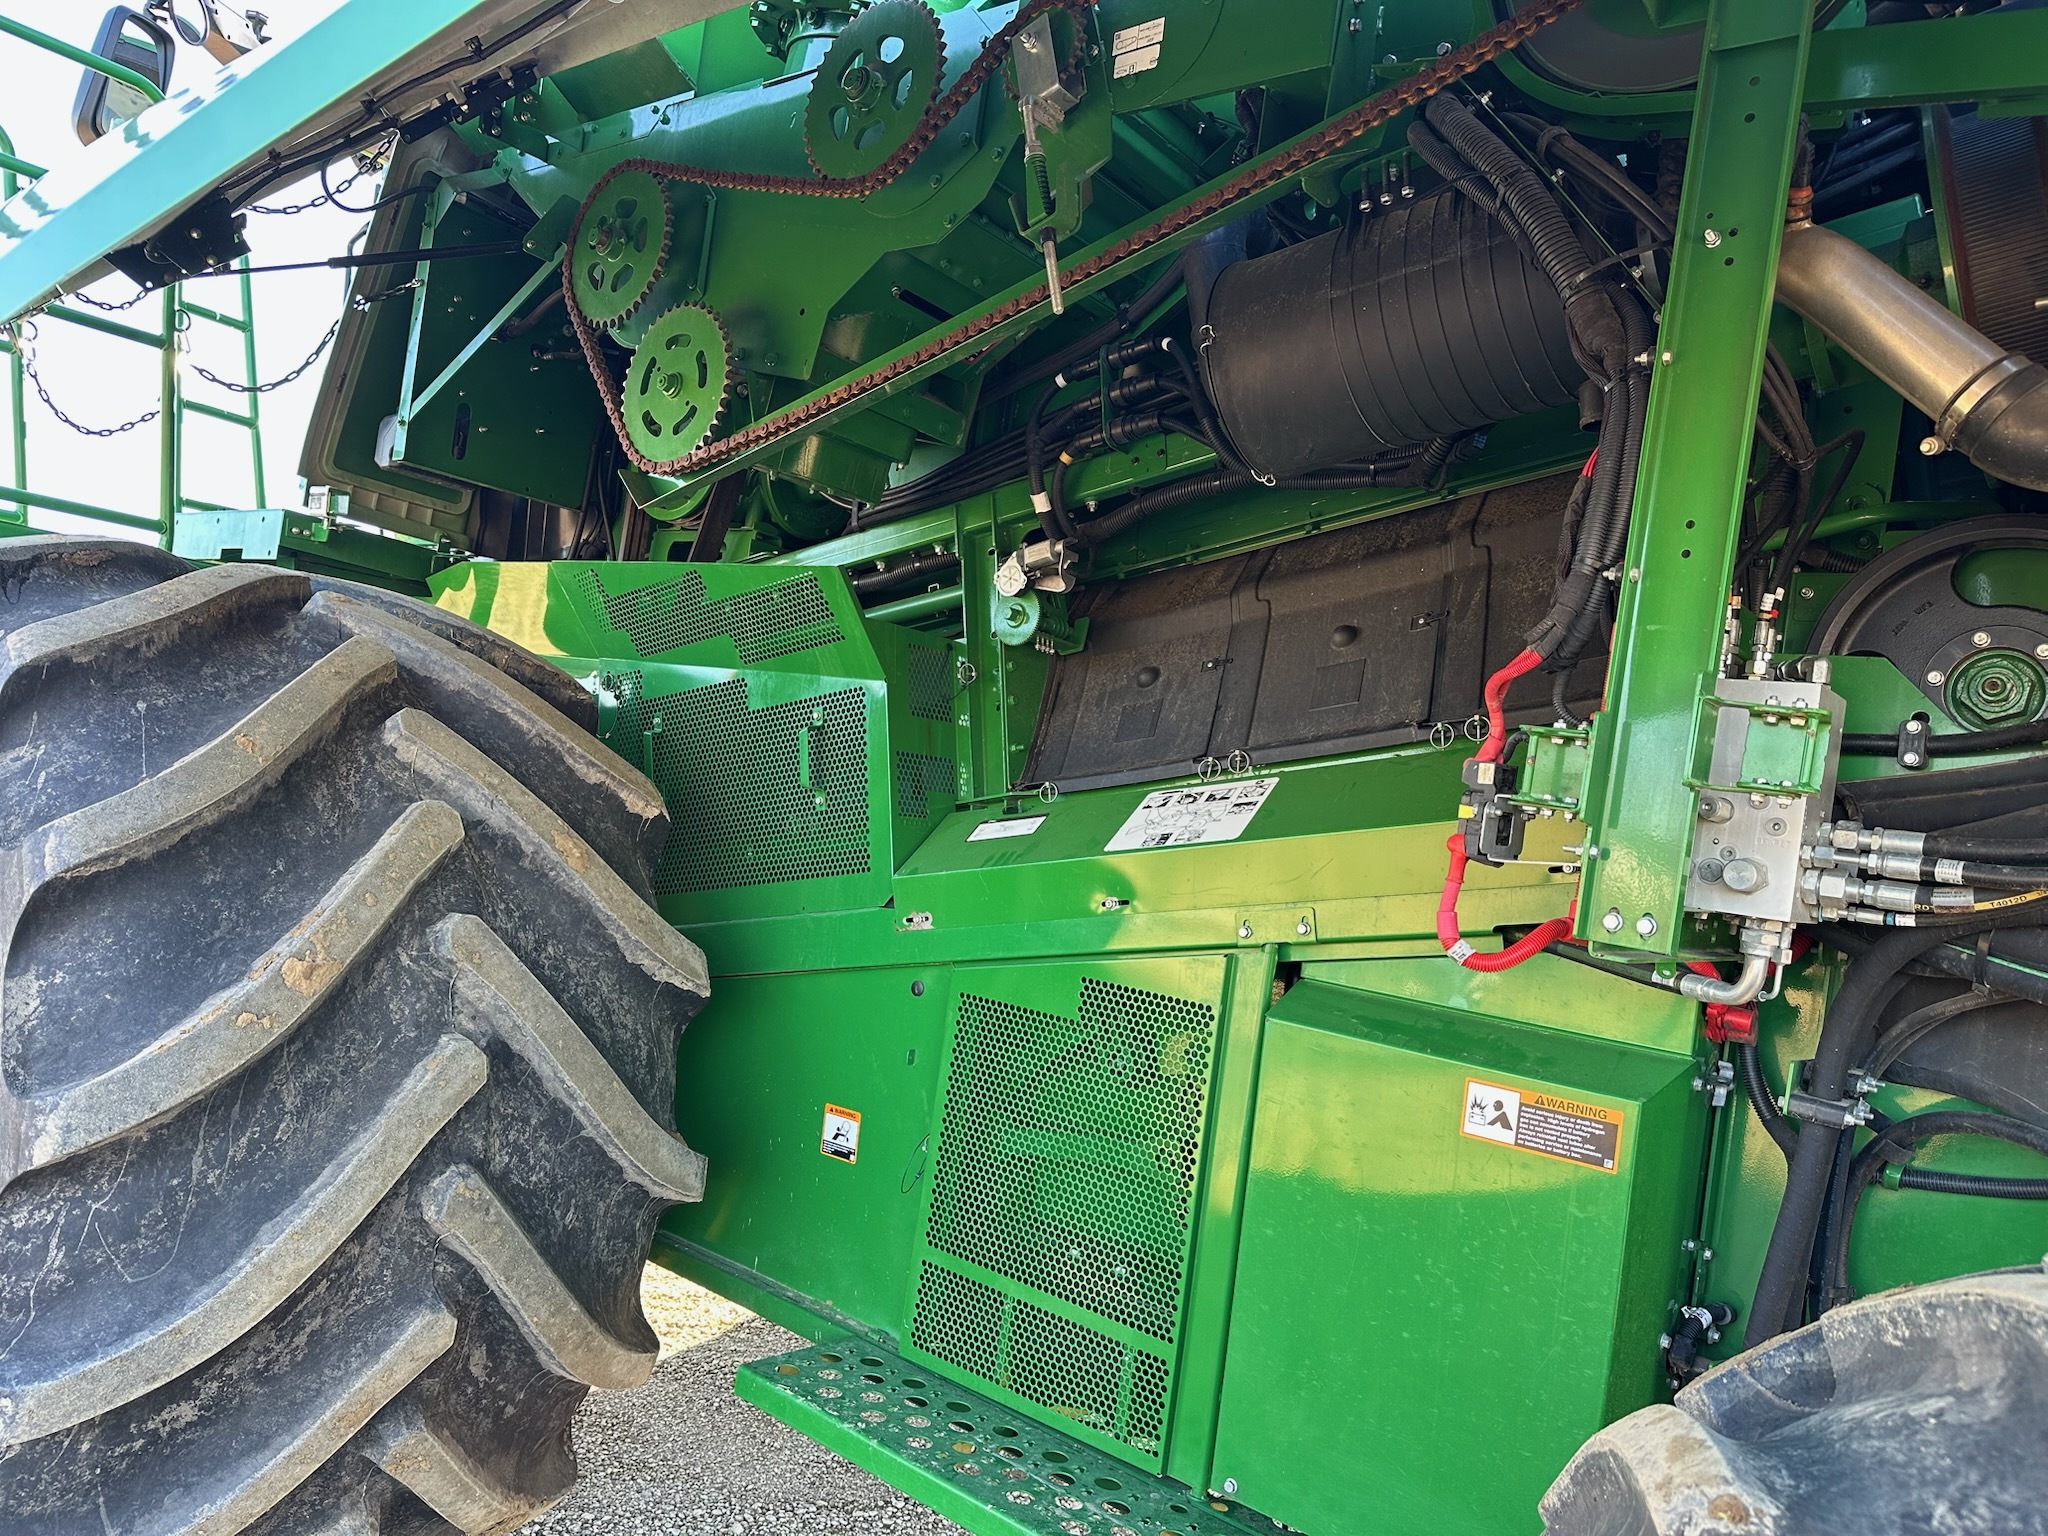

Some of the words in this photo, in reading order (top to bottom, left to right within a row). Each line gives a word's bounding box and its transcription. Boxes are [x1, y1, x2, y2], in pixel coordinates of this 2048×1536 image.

[1989, 895, 2028, 908] T4012D
[835, 1108, 856, 1119] WARNING
[1546, 1097, 1608, 1120] WARNING
